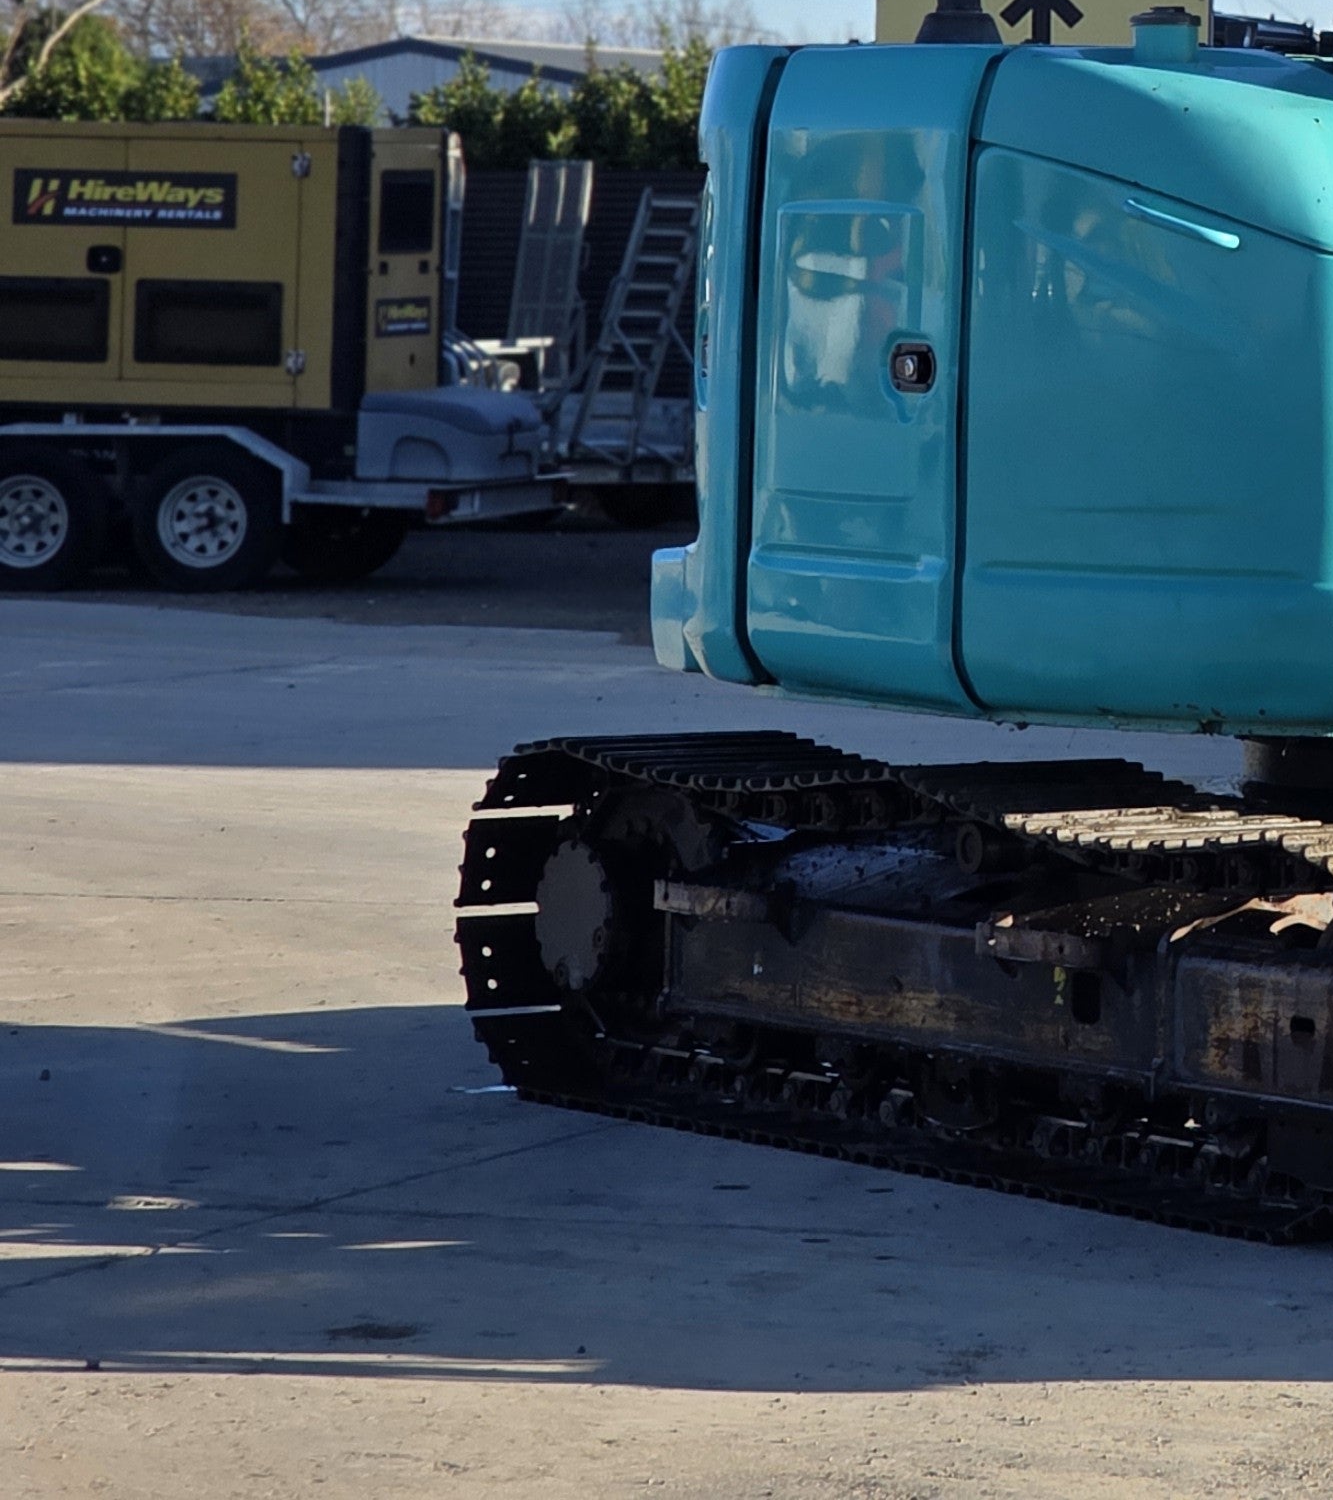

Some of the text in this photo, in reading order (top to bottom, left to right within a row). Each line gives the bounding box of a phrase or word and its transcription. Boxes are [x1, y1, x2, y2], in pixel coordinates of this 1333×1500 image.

[67, 179, 225, 208] HireWays
[63, 207, 222, 220] MACHINERY RENTALS
